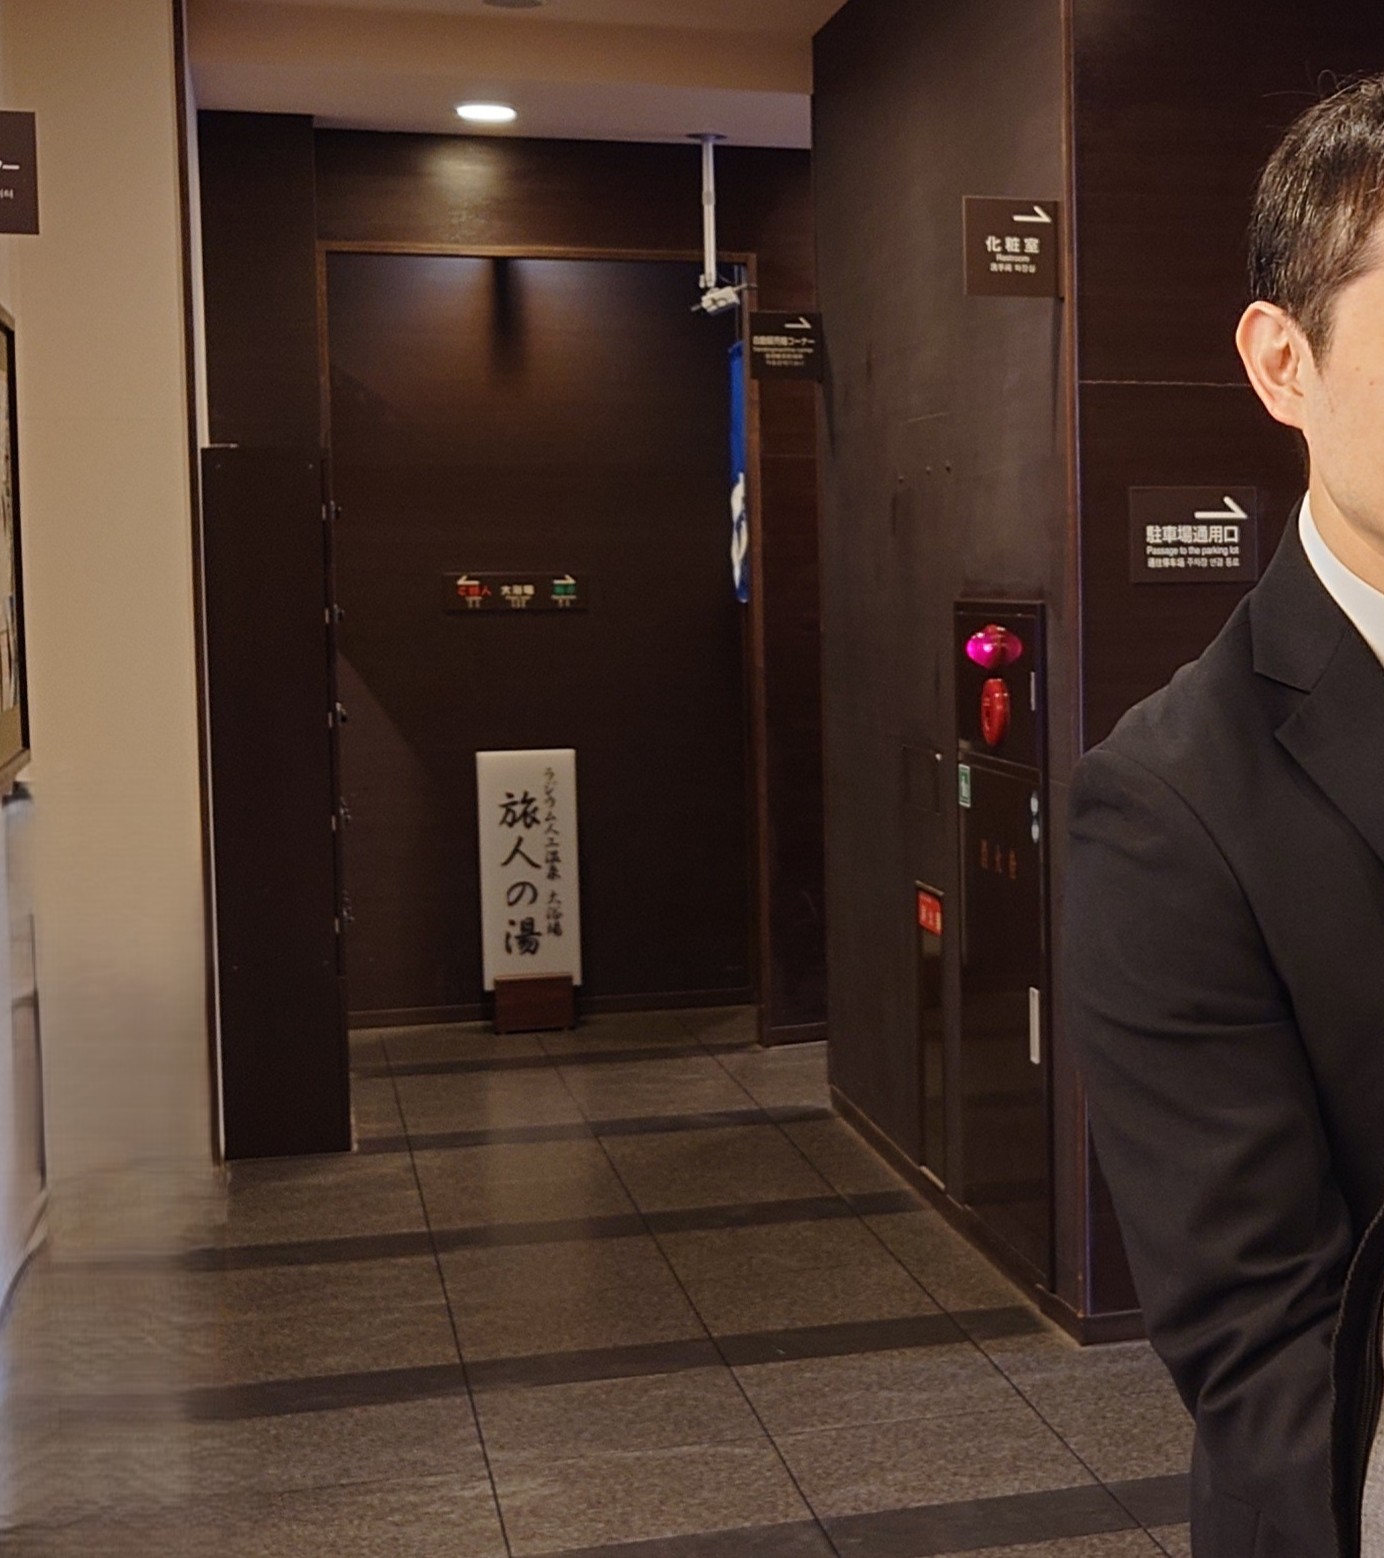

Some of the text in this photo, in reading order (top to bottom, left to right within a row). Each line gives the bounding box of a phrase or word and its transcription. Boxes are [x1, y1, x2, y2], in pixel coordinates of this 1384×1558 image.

[985, 235, 1040, 253] 化粧室
[1146, 525, 1239, 543] 駐車場通用口
[1146, 546, 1179, 556] Passage
[1180, 546, 1187, 555] to
[1188, 546, 1200, 555] the
[1201, 546, 1228, 557] parking
[499, 791, 542, 955] 旅人の湯
